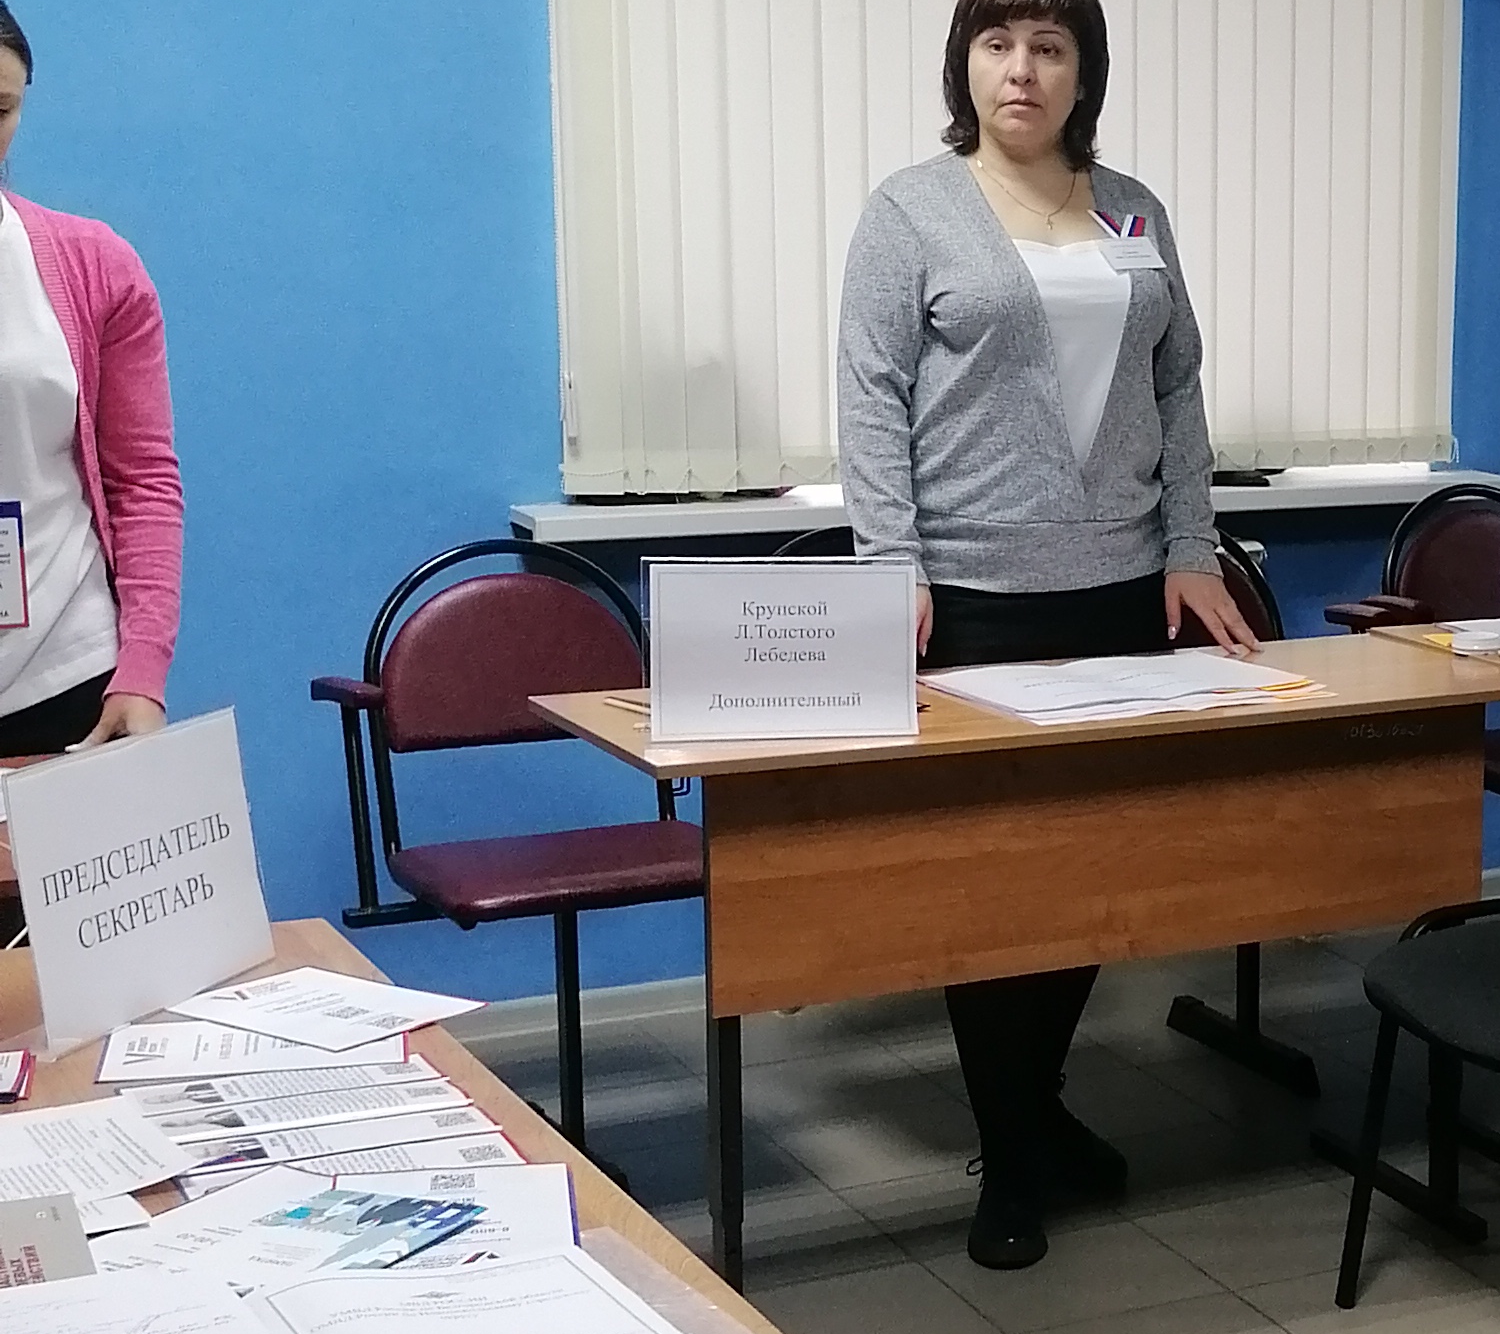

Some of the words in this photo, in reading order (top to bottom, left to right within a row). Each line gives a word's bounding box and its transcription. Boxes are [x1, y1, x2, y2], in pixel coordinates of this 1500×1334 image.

[742, 601, 828, 620] Крупской
[734, 624, 836, 640] Л.Толстого
[744, 647, 826, 663] Лебедева
[709, 692, 862, 711] Дополнительный
[40, 812, 231, 907] ПРЕДСЕДАТЕЛЬ
[77, 872, 215, 949] СЕКРЕТАРЬ
